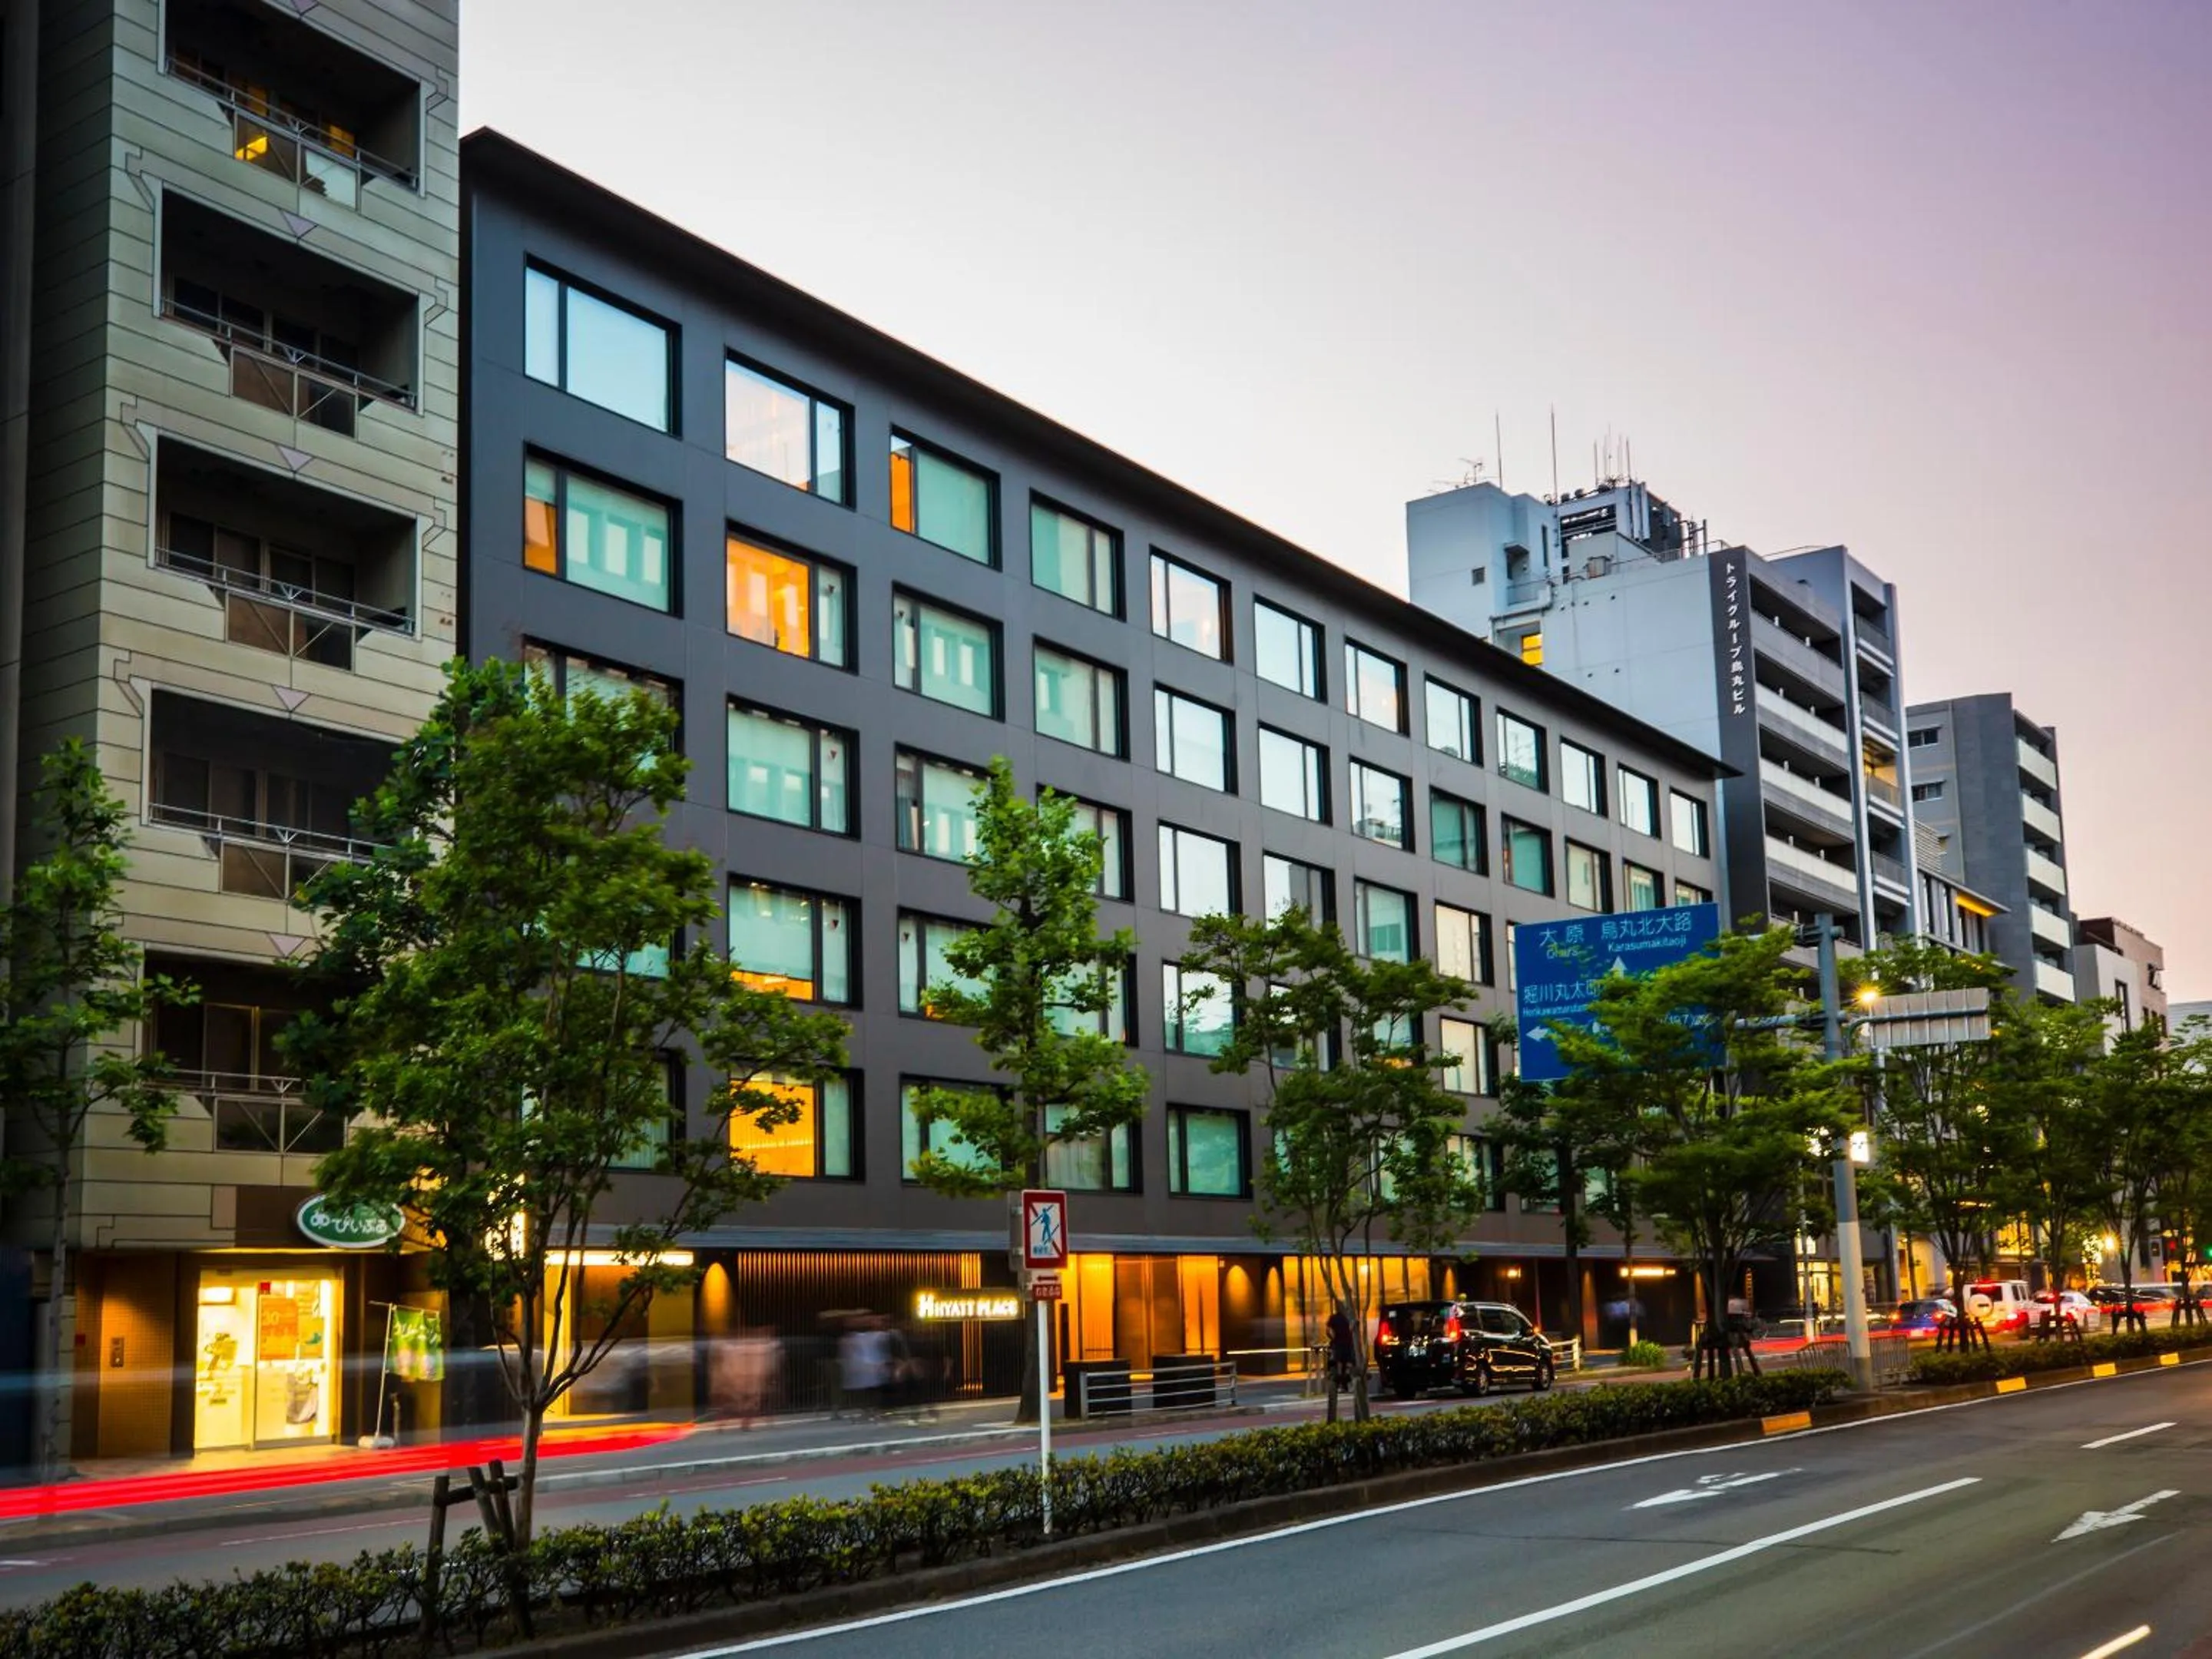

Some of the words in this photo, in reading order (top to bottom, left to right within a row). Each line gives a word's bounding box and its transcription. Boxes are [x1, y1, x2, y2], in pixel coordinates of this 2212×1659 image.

[1601, 911, 1692, 940] 烏丸北大路
